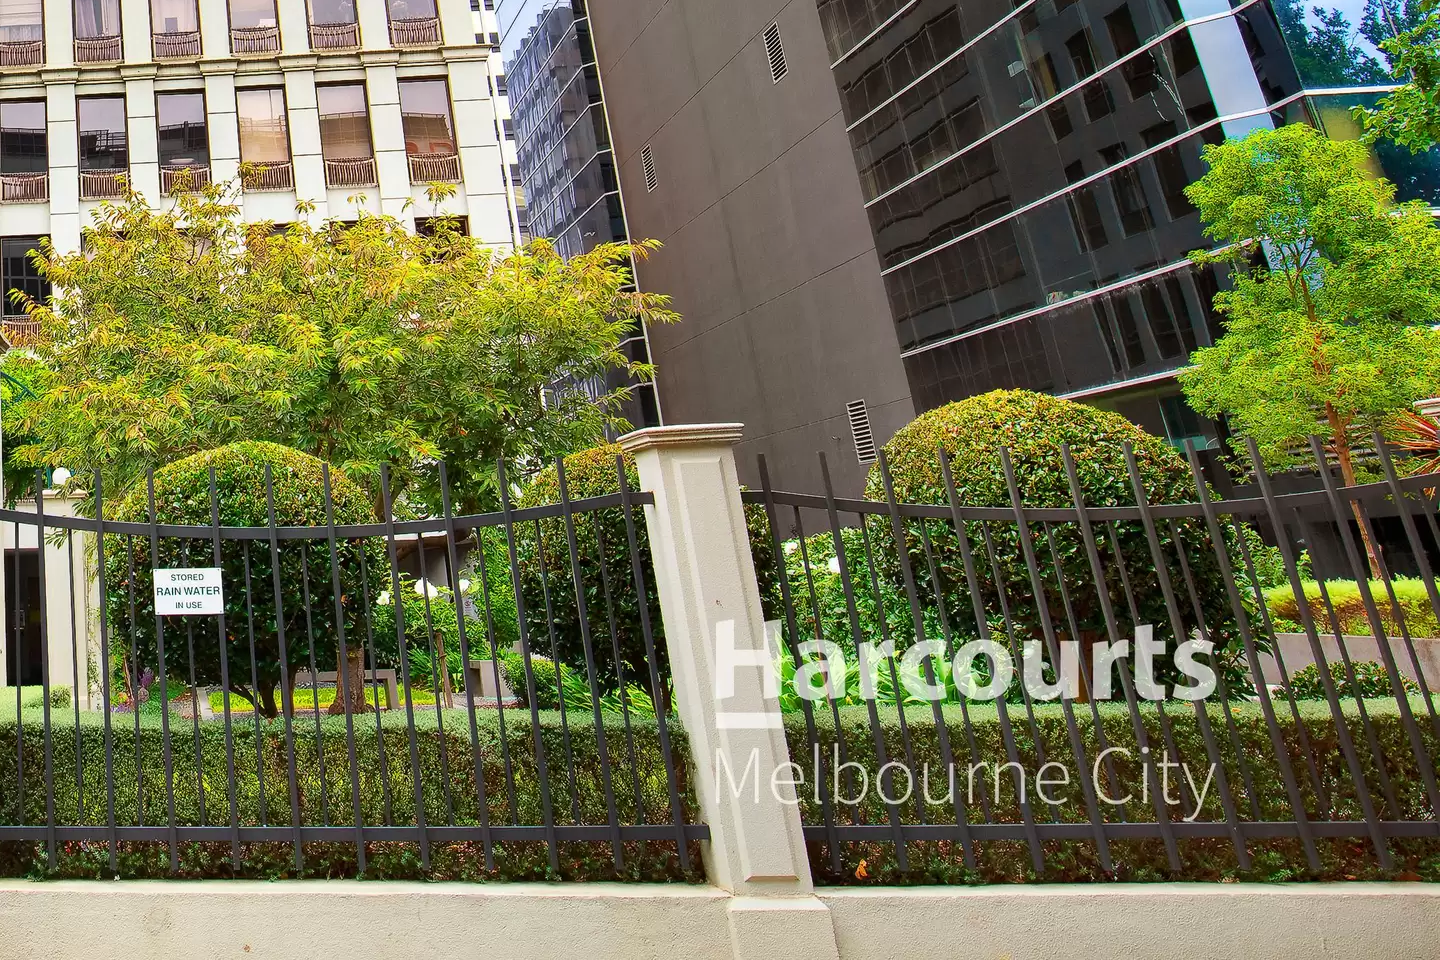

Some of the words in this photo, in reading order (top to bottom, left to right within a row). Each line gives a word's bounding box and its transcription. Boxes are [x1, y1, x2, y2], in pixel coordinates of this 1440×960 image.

[170, 573, 205, 582] STORED
[156, 586, 182, 596] RAIN
[183, 586, 221, 596] WATER
[175, 601, 184, 609] IN
[185, 601, 203, 609] USE
